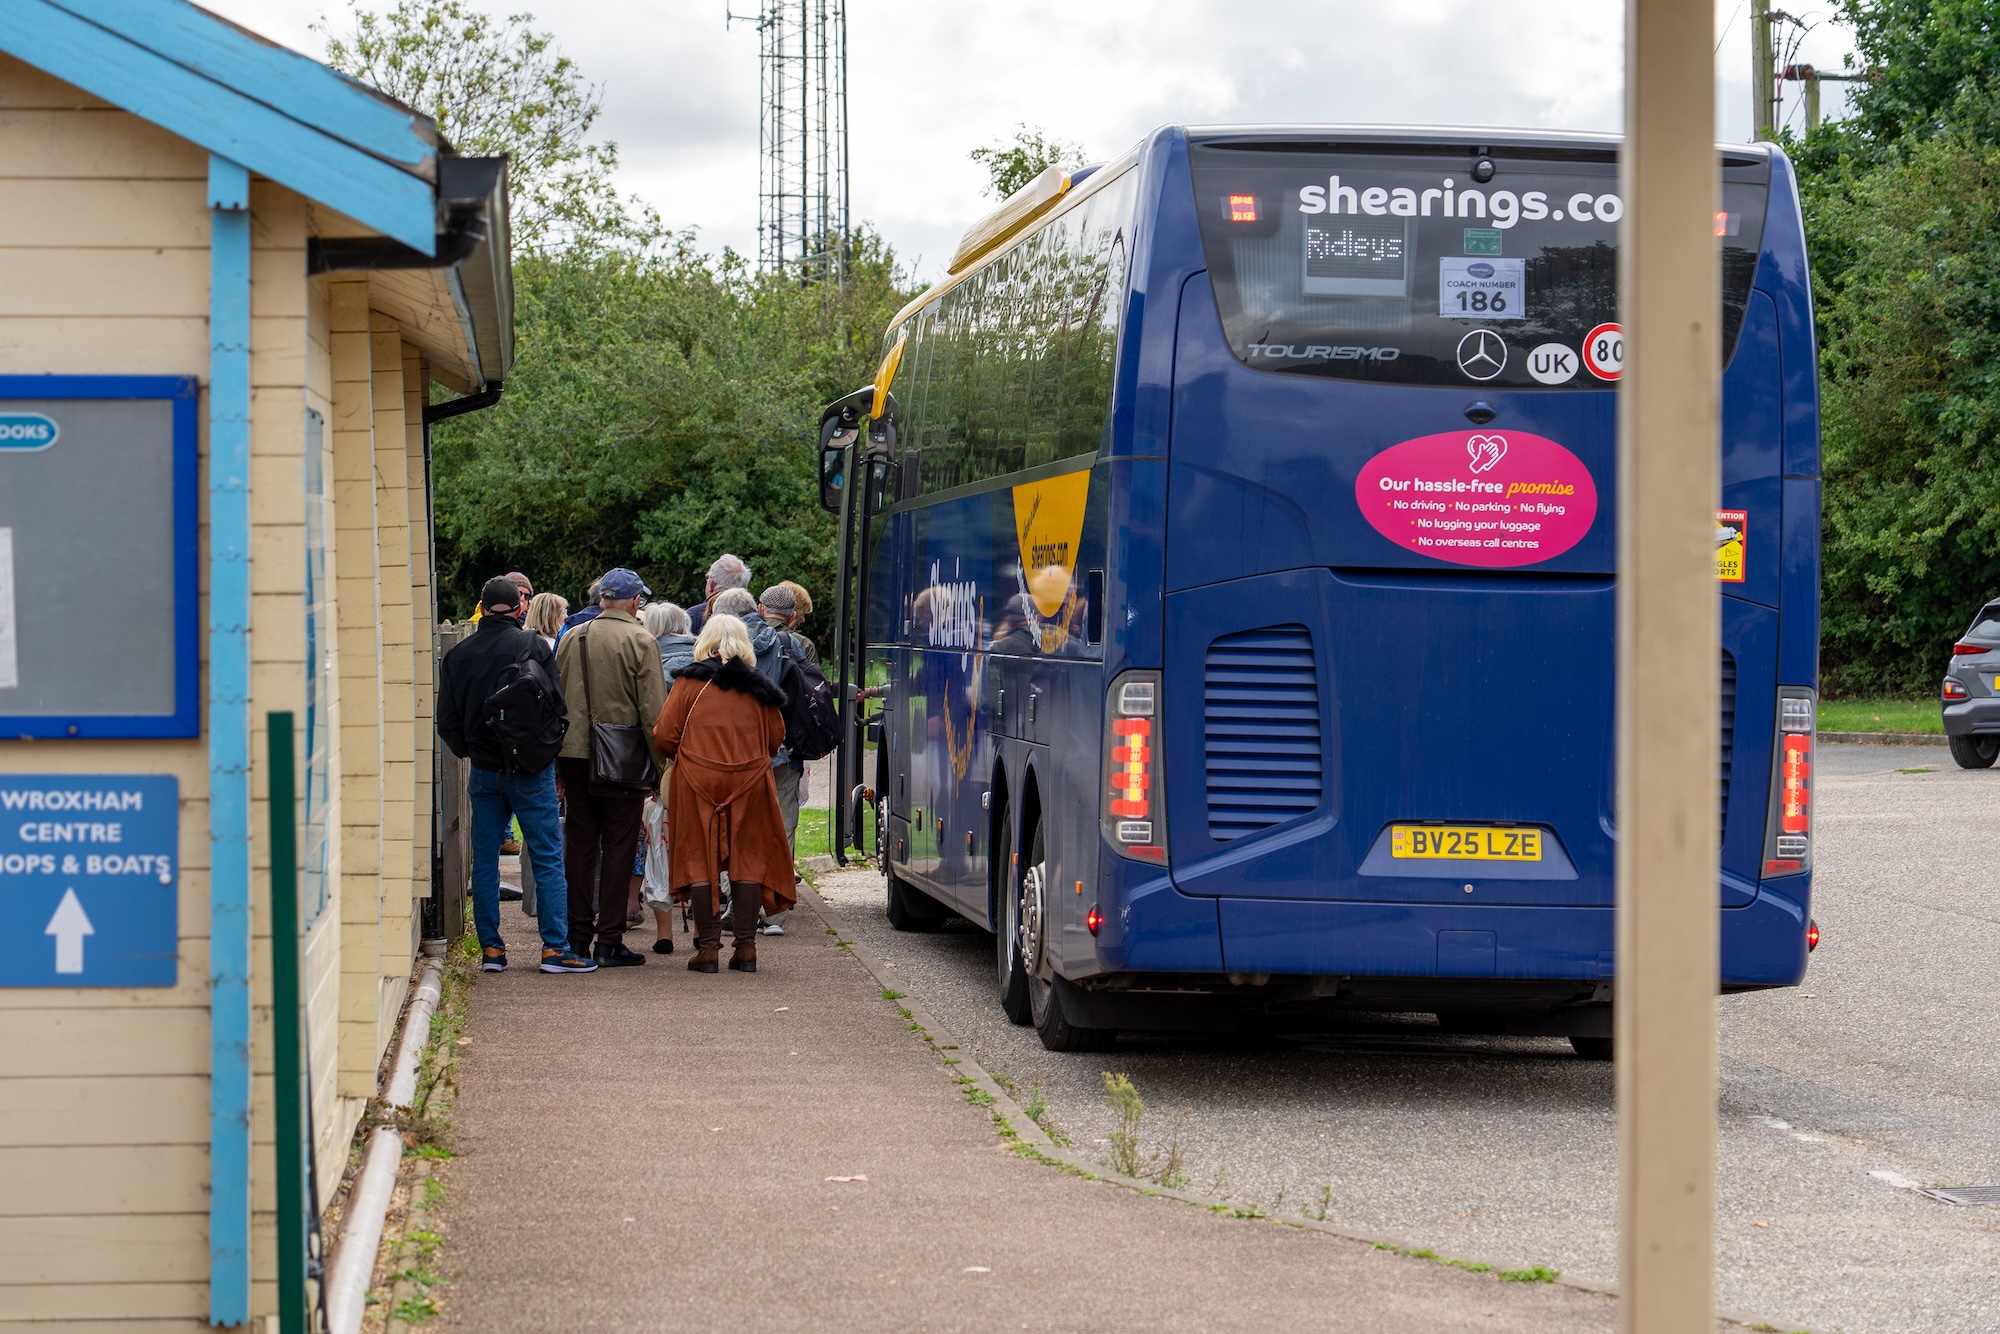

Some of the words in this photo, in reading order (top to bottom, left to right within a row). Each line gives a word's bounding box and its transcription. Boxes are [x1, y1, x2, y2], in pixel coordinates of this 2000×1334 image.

[1308, 229, 1402, 261] Ridleys
[1447, 280, 1477, 288] COACH
[1479, 281, 1516, 289] NUMBER
[1456, 290, 1506, 312] 186
[1247, 343, 1400, 361] TOURISMO
[1597, 339, 1624, 362] 80
[1534, 353, 1571, 374] UK
[1379, 477, 1410, 491] Our
[1414, 477, 1503, 493] hassle-free
[1505, 480, 1575, 499] promise
[1393, 500, 1408, 509] No
[1410, 500, 1446, 513] driving
[1455, 501, 1470, 511] No
[1471, 502, 1510, 514] parking
[1520, 503, 1535, 513] No
[1537, 503, 1565, 515] flying
[1417, 518, 1432, 528] No
[1434, 519, 1472, 531] lugging
[1474, 521, 1498, 531] your
[1500, 520, 1541, 533] luggage
[1418, 536, 1433, 546] No
[1435, 538, 1481, 547] overseas
[1483, 537, 1499, 548] call
[1501, 539, 1539, 549] centres
[1, 791, 143, 811] WROXHAM
[19, 822, 122, 843] CENTRE
[1412, 831, 1479, 854] BV25
[1487, 833, 1537, 857] LZE
[61, 854, 80, 875] &
[86, 855, 171, 876] BOATS
